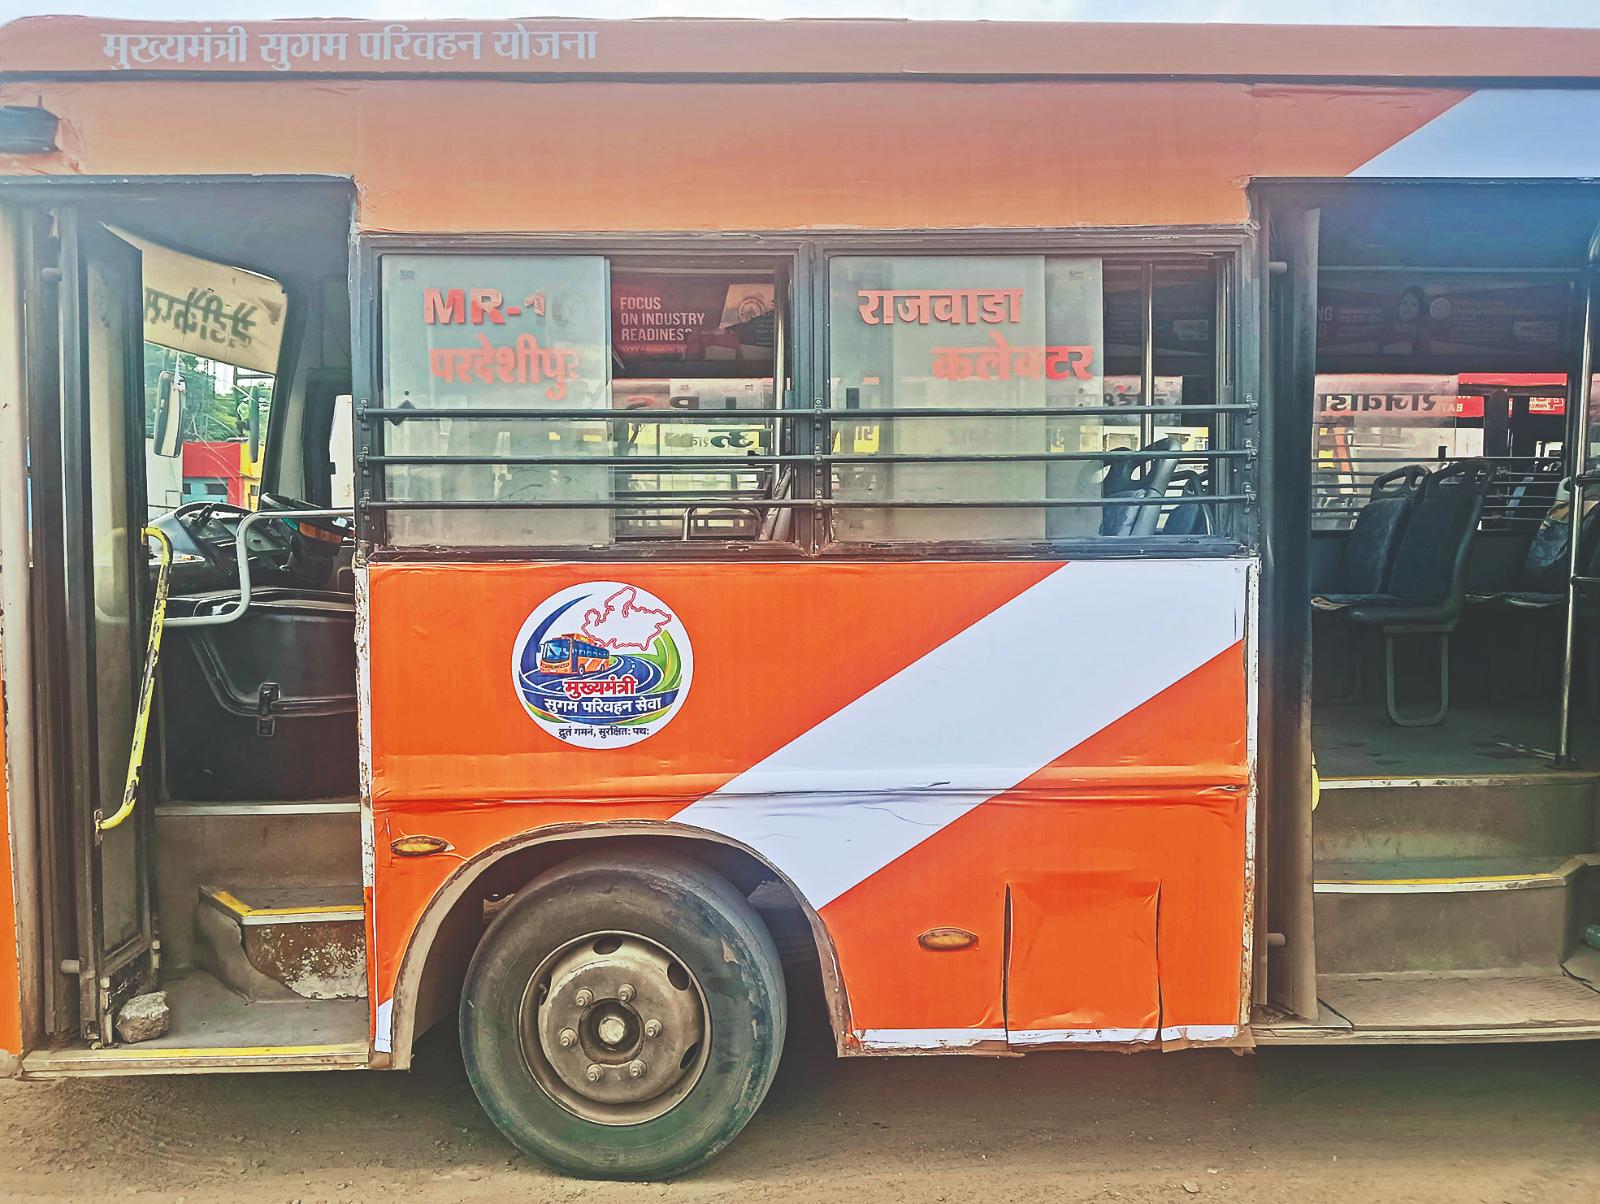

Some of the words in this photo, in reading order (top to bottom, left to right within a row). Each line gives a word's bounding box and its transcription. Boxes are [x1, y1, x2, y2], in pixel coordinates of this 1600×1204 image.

[101, 26, 249, 70] मुख्यमंत्री
[259, 31, 349, 70] सुगम
[358, 24, 482, 60] परिवहन
[493, 23, 599, 60] योजना
[620, 296, 662, 311] FOCUS
[858, 288, 1024, 326] राजवाडा
[621, 312, 639, 326] ON
[642, 312, 705, 326] INDUSTRY
[564, 676, 636, 699] मुख्यमंत्री
[544, 698, 579, 714] सुगम
[582, 698, 633, 714] परिवहन
[635, 696, 662, 712] सेवा
